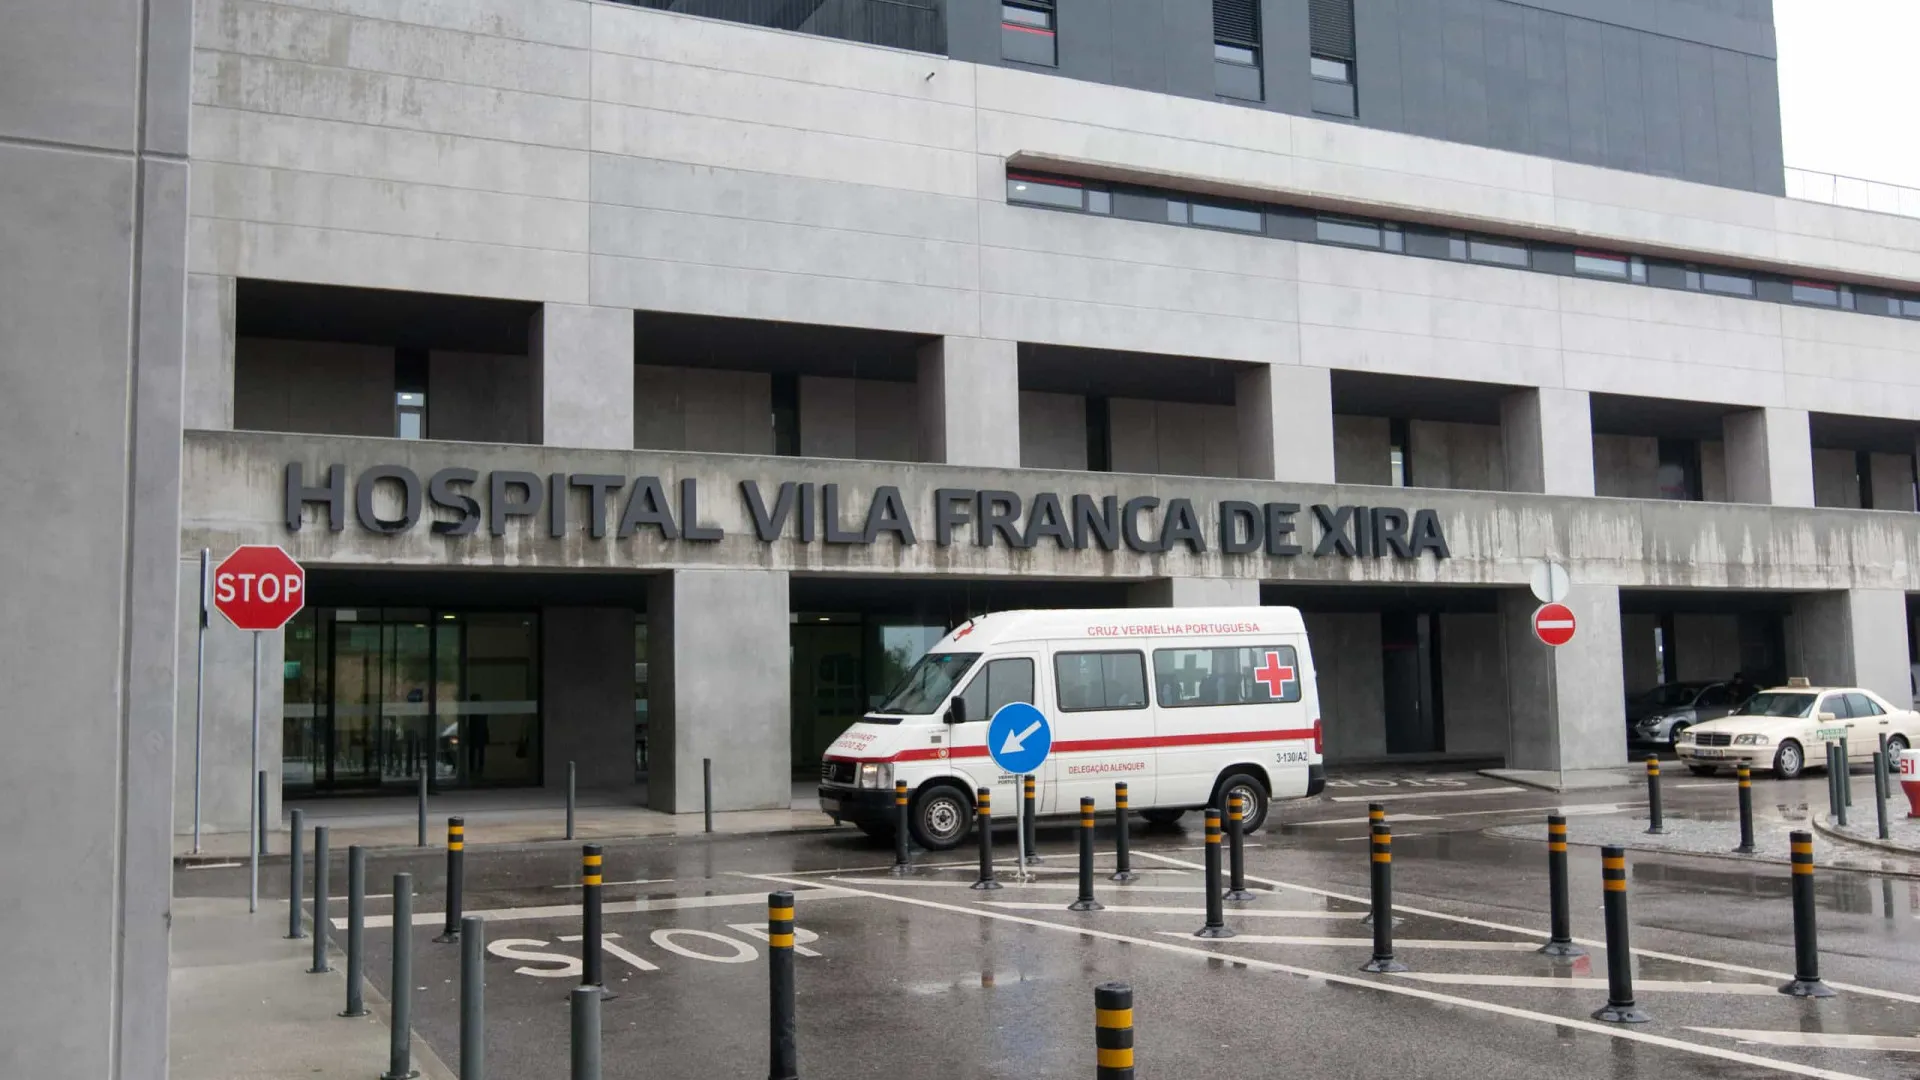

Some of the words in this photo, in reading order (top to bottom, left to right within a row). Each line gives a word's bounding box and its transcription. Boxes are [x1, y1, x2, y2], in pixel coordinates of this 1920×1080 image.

[285, 461, 725, 541] HOSPITAL
[740, 480, 918, 546] VILA
[934, 488, 1207, 554] FRANCA
[1219, 500, 1303, 556] DE
[1311, 504, 1451, 559] XIRA
[216, 573, 302, 603] STOP
[1087, 626, 1118, 636] CRUZ
[1121, 625, 1183, 635] VERMELHA
[1186, 623, 1260, 633] PORTUGUESA
[1110, 762, 1145, 771] ALENQUER
[487, 923, 823, 978] STOP
